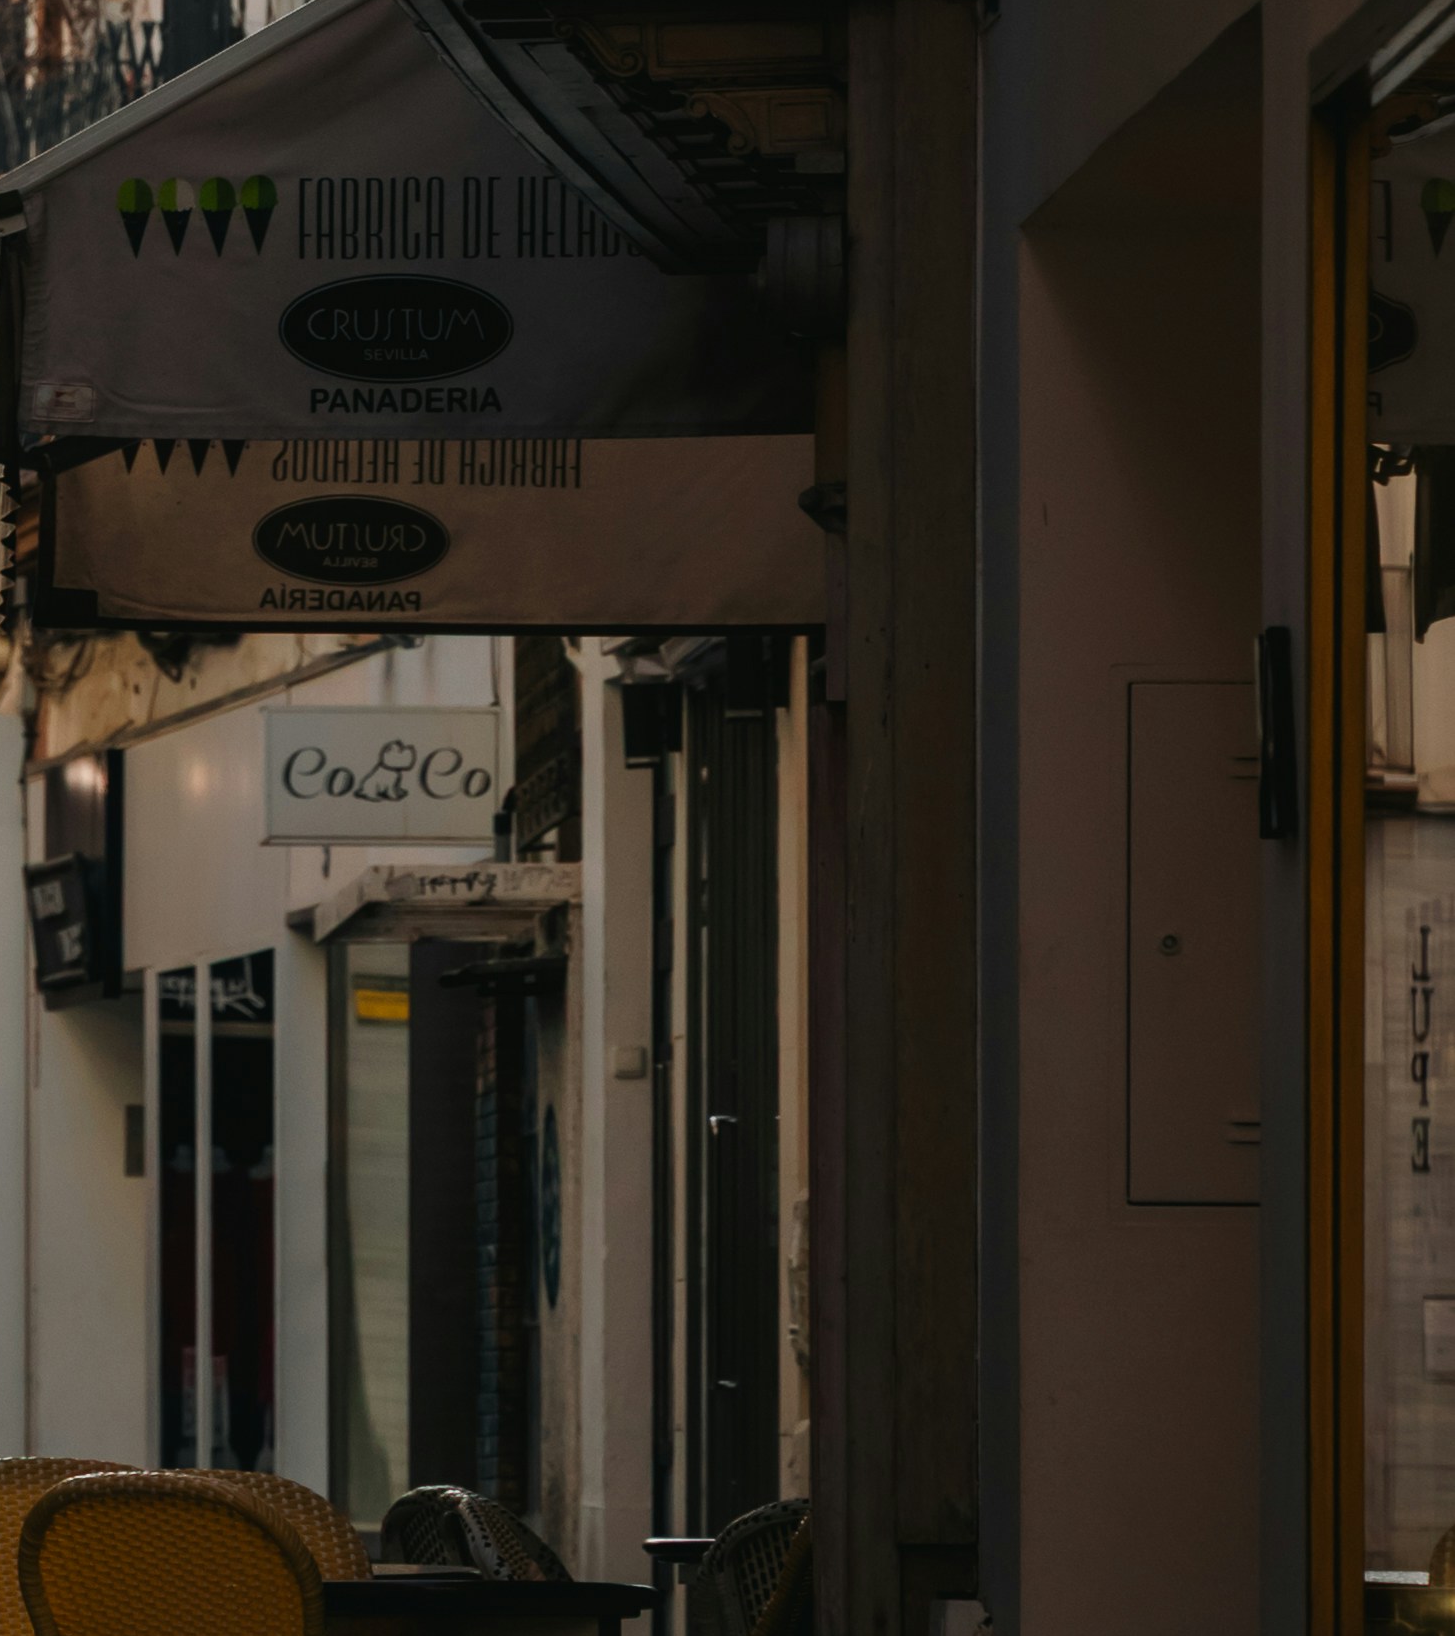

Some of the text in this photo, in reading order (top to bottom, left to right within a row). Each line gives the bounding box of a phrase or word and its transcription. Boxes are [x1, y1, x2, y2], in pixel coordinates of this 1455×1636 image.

[298, 176, 445, 261] FABRICA
[462, 176, 502, 260] DE
[305, 307, 486, 342] CRUSTUM
[363, 347, 431, 362] SEVILLA
[310, 387, 503, 414] PANADERIA
